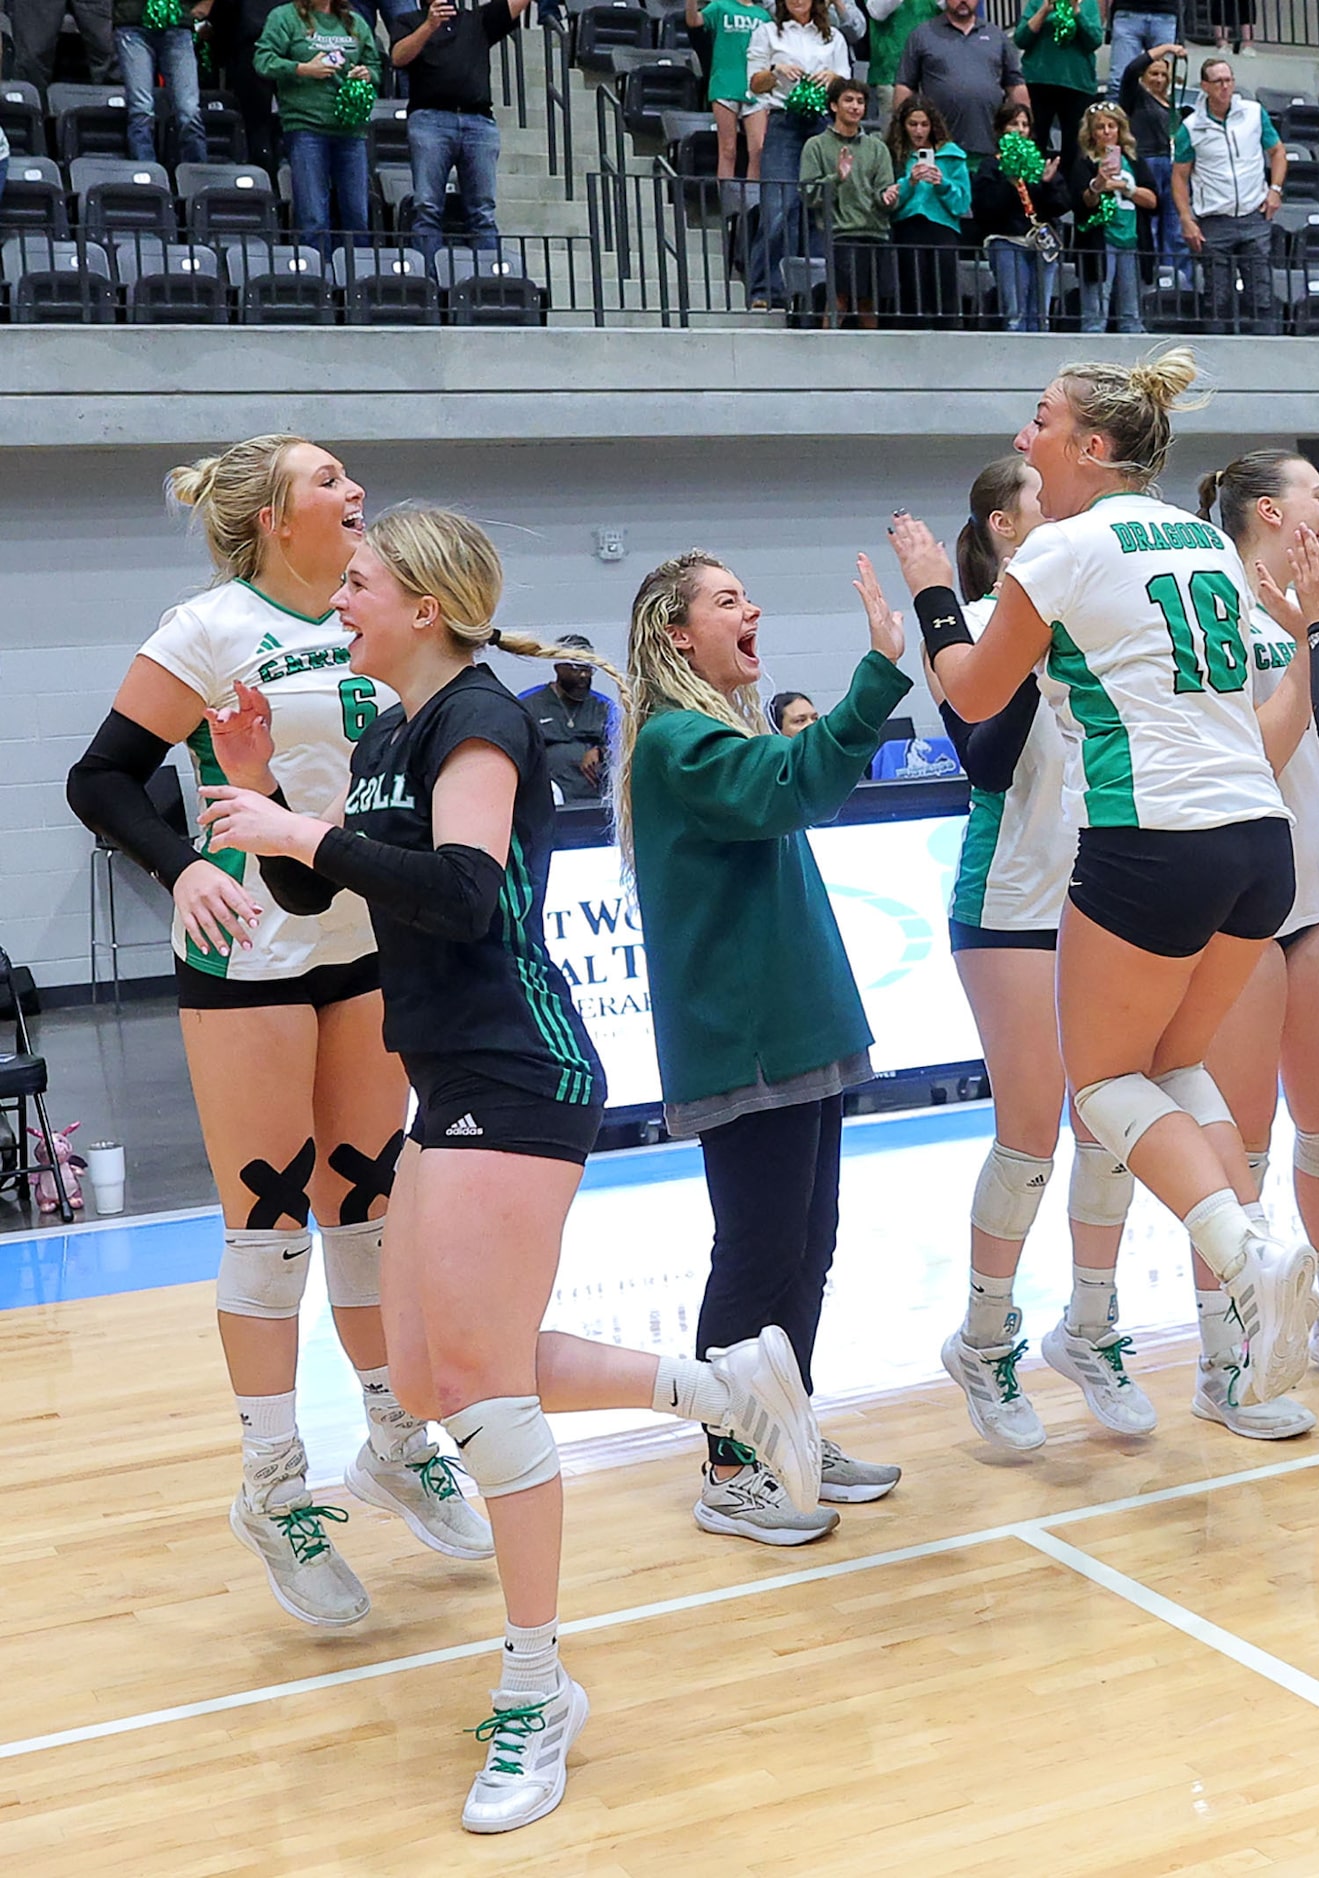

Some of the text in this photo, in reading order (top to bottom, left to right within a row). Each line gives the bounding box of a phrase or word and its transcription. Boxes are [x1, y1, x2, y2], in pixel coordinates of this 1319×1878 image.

[1110, 521, 1225, 554] DRAGONS
[1145, 570, 1248, 694] 18
[338, 676, 378, 742] 6
[445, 1125, 483, 1136] adidas
